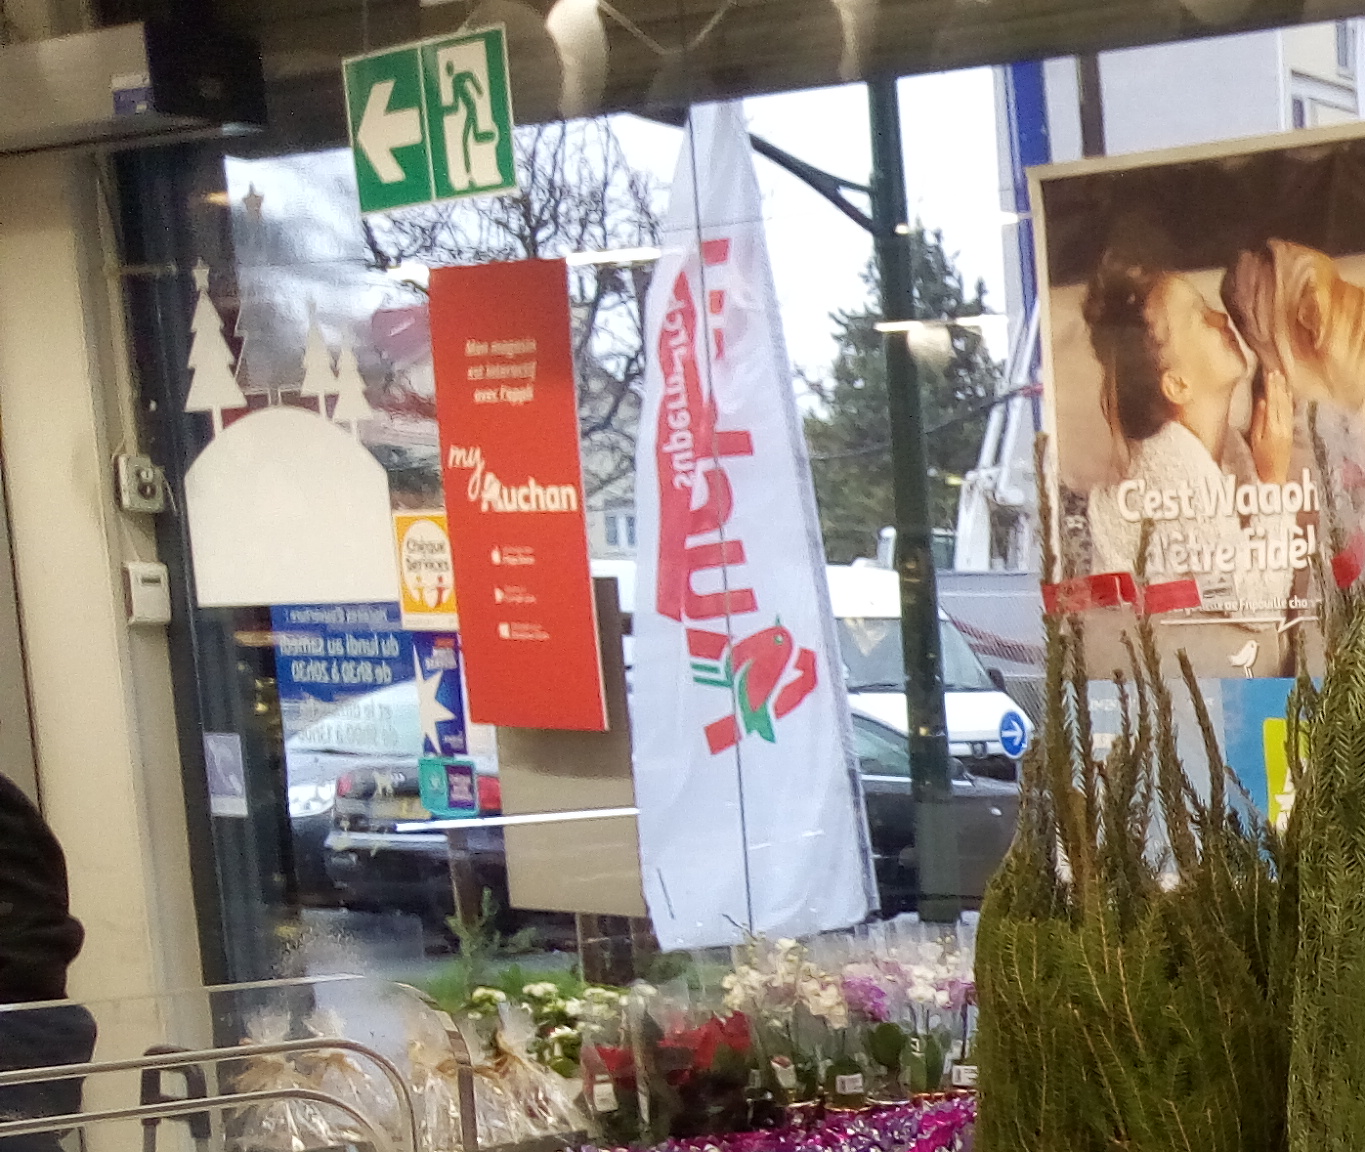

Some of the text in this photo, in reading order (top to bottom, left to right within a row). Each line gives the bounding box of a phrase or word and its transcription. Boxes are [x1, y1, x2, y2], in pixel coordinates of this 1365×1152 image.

[448, 444, 578, 512] my Auchan
[1200, 466, 1319, 517] Waaoh
